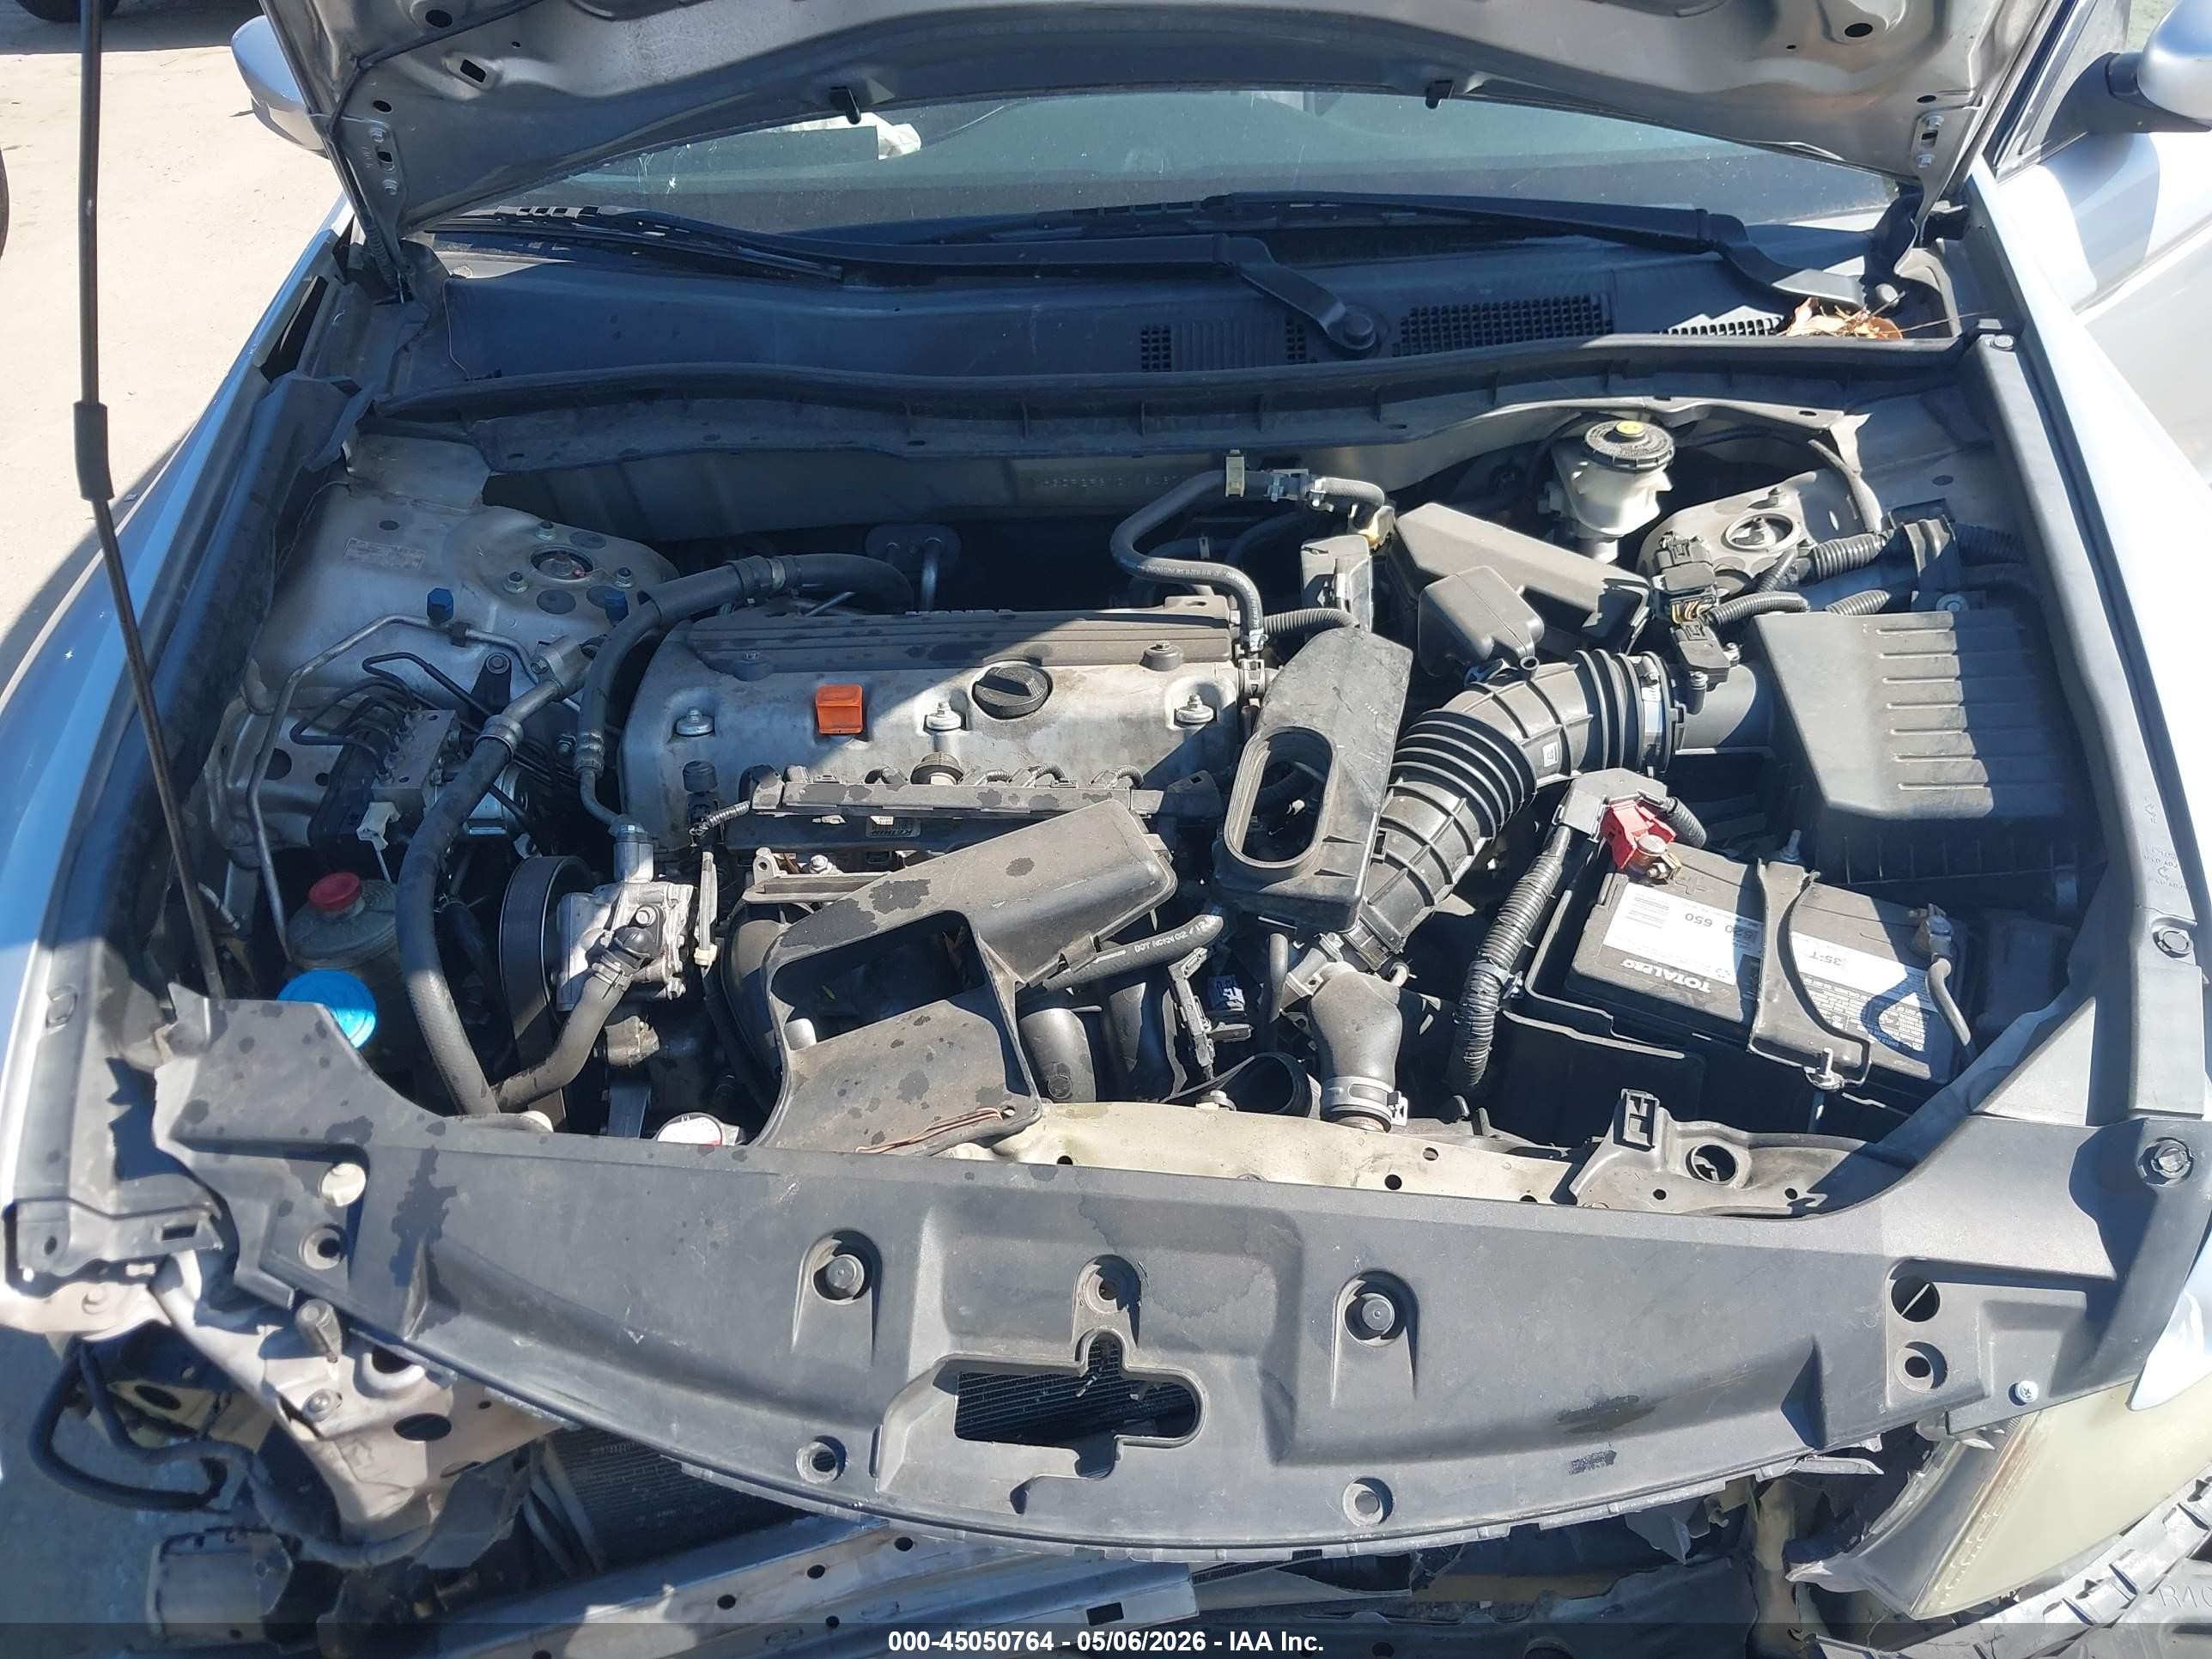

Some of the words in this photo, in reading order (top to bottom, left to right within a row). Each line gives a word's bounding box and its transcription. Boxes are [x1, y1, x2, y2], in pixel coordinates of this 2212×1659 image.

[1685, 913, 1713, 927] 650
[1133, 944, 1151, 953] DOT
[1621, 958, 1711, 993] TOTALPRO
